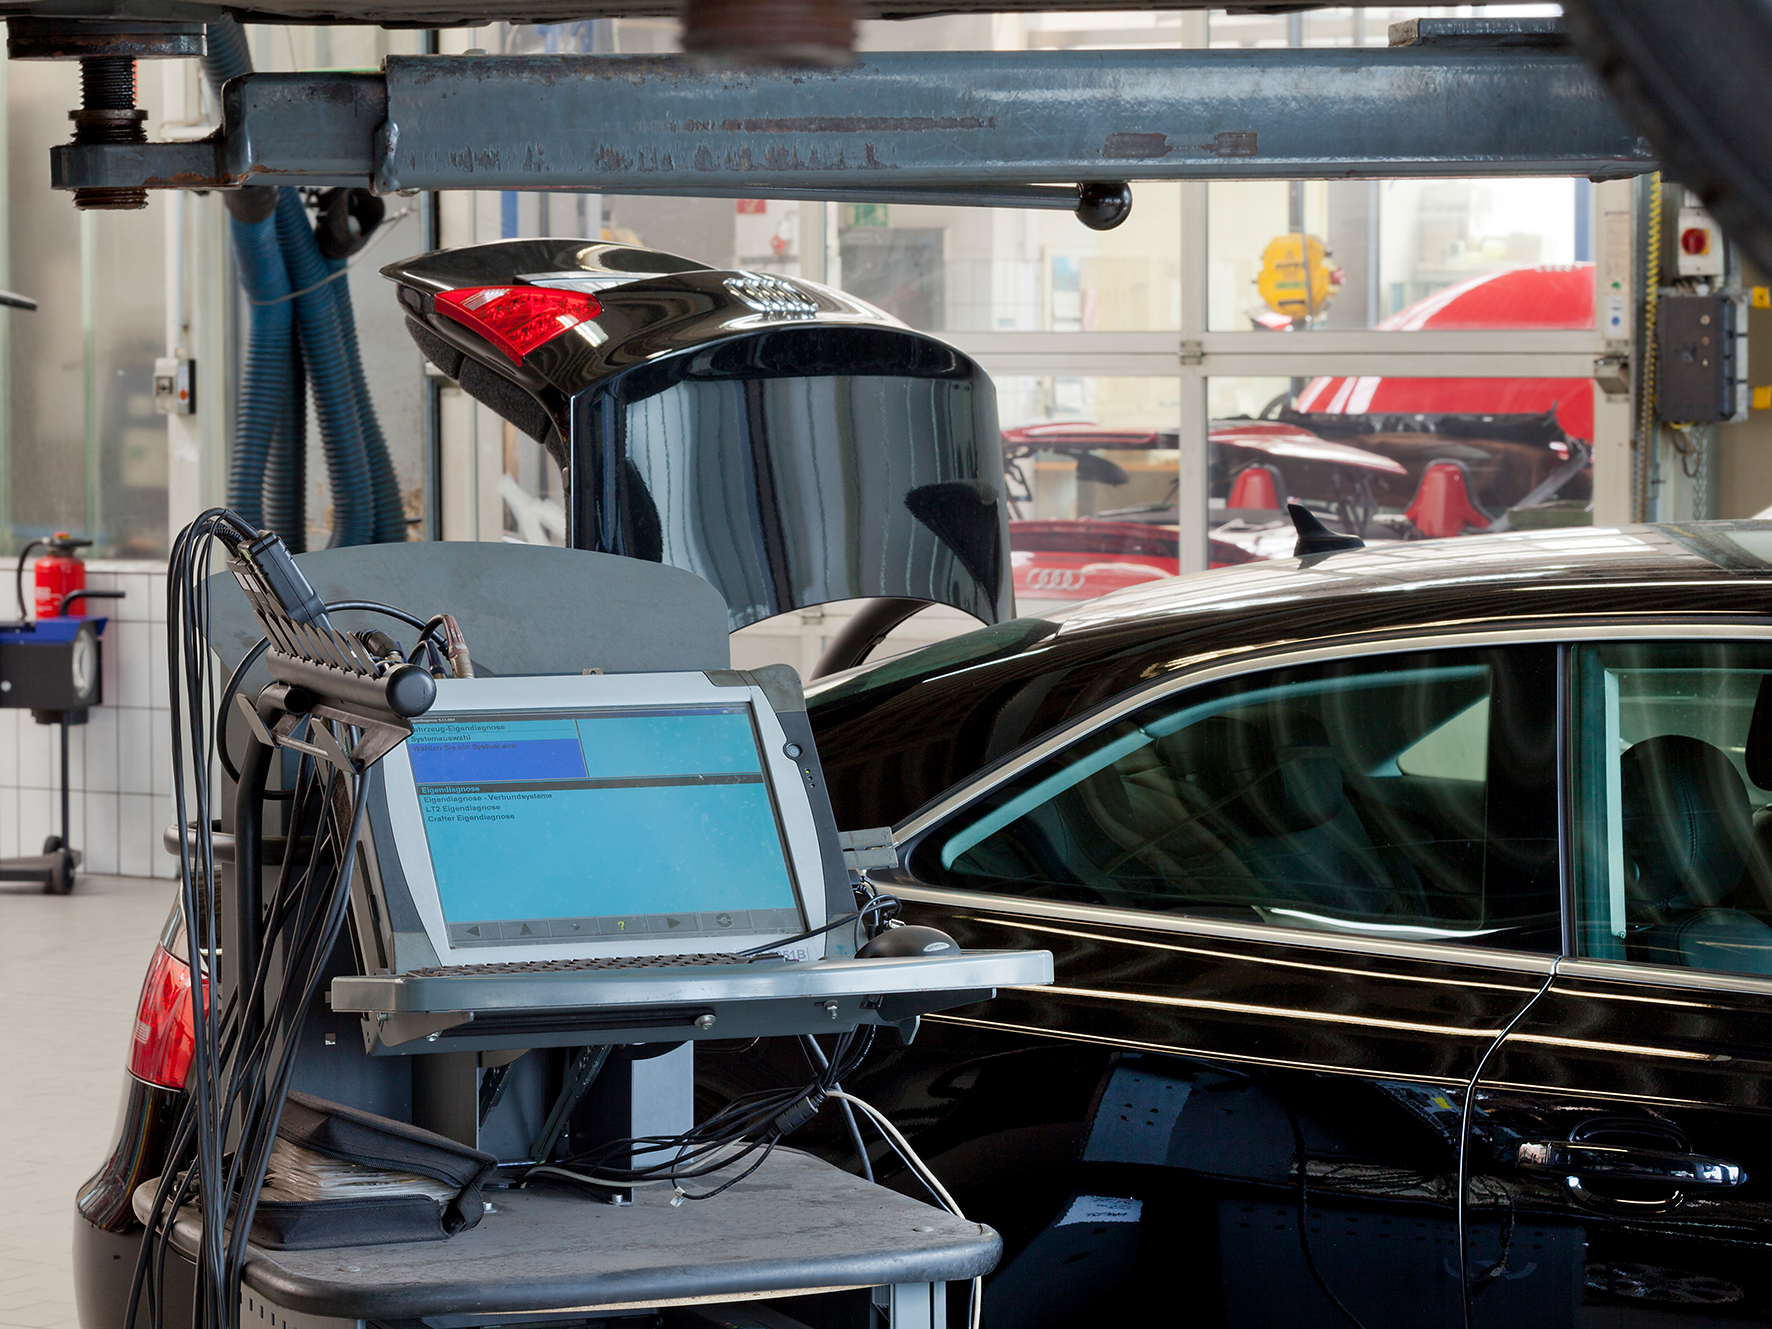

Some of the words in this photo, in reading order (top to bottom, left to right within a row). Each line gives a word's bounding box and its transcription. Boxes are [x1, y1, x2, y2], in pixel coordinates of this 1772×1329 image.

[413, 724, 506, 734] ahrzeug-Eigendiagnose
[411, 734, 472, 743] Systemauswahl
[472, 743, 500, 751] System
[421, 785, 480, 795] Eigendiagnose
[424, 795, 482, 805] Eigendiagnose
[488, 793, 553, 802] Verbundsysteme
[426, 805, 441, 813] LT2
[443, 804, 501, 814] Eigendiagnose
[428, 815, 455, 823] Crafter
[457, 813, 515, 823] Eigendiagnose
